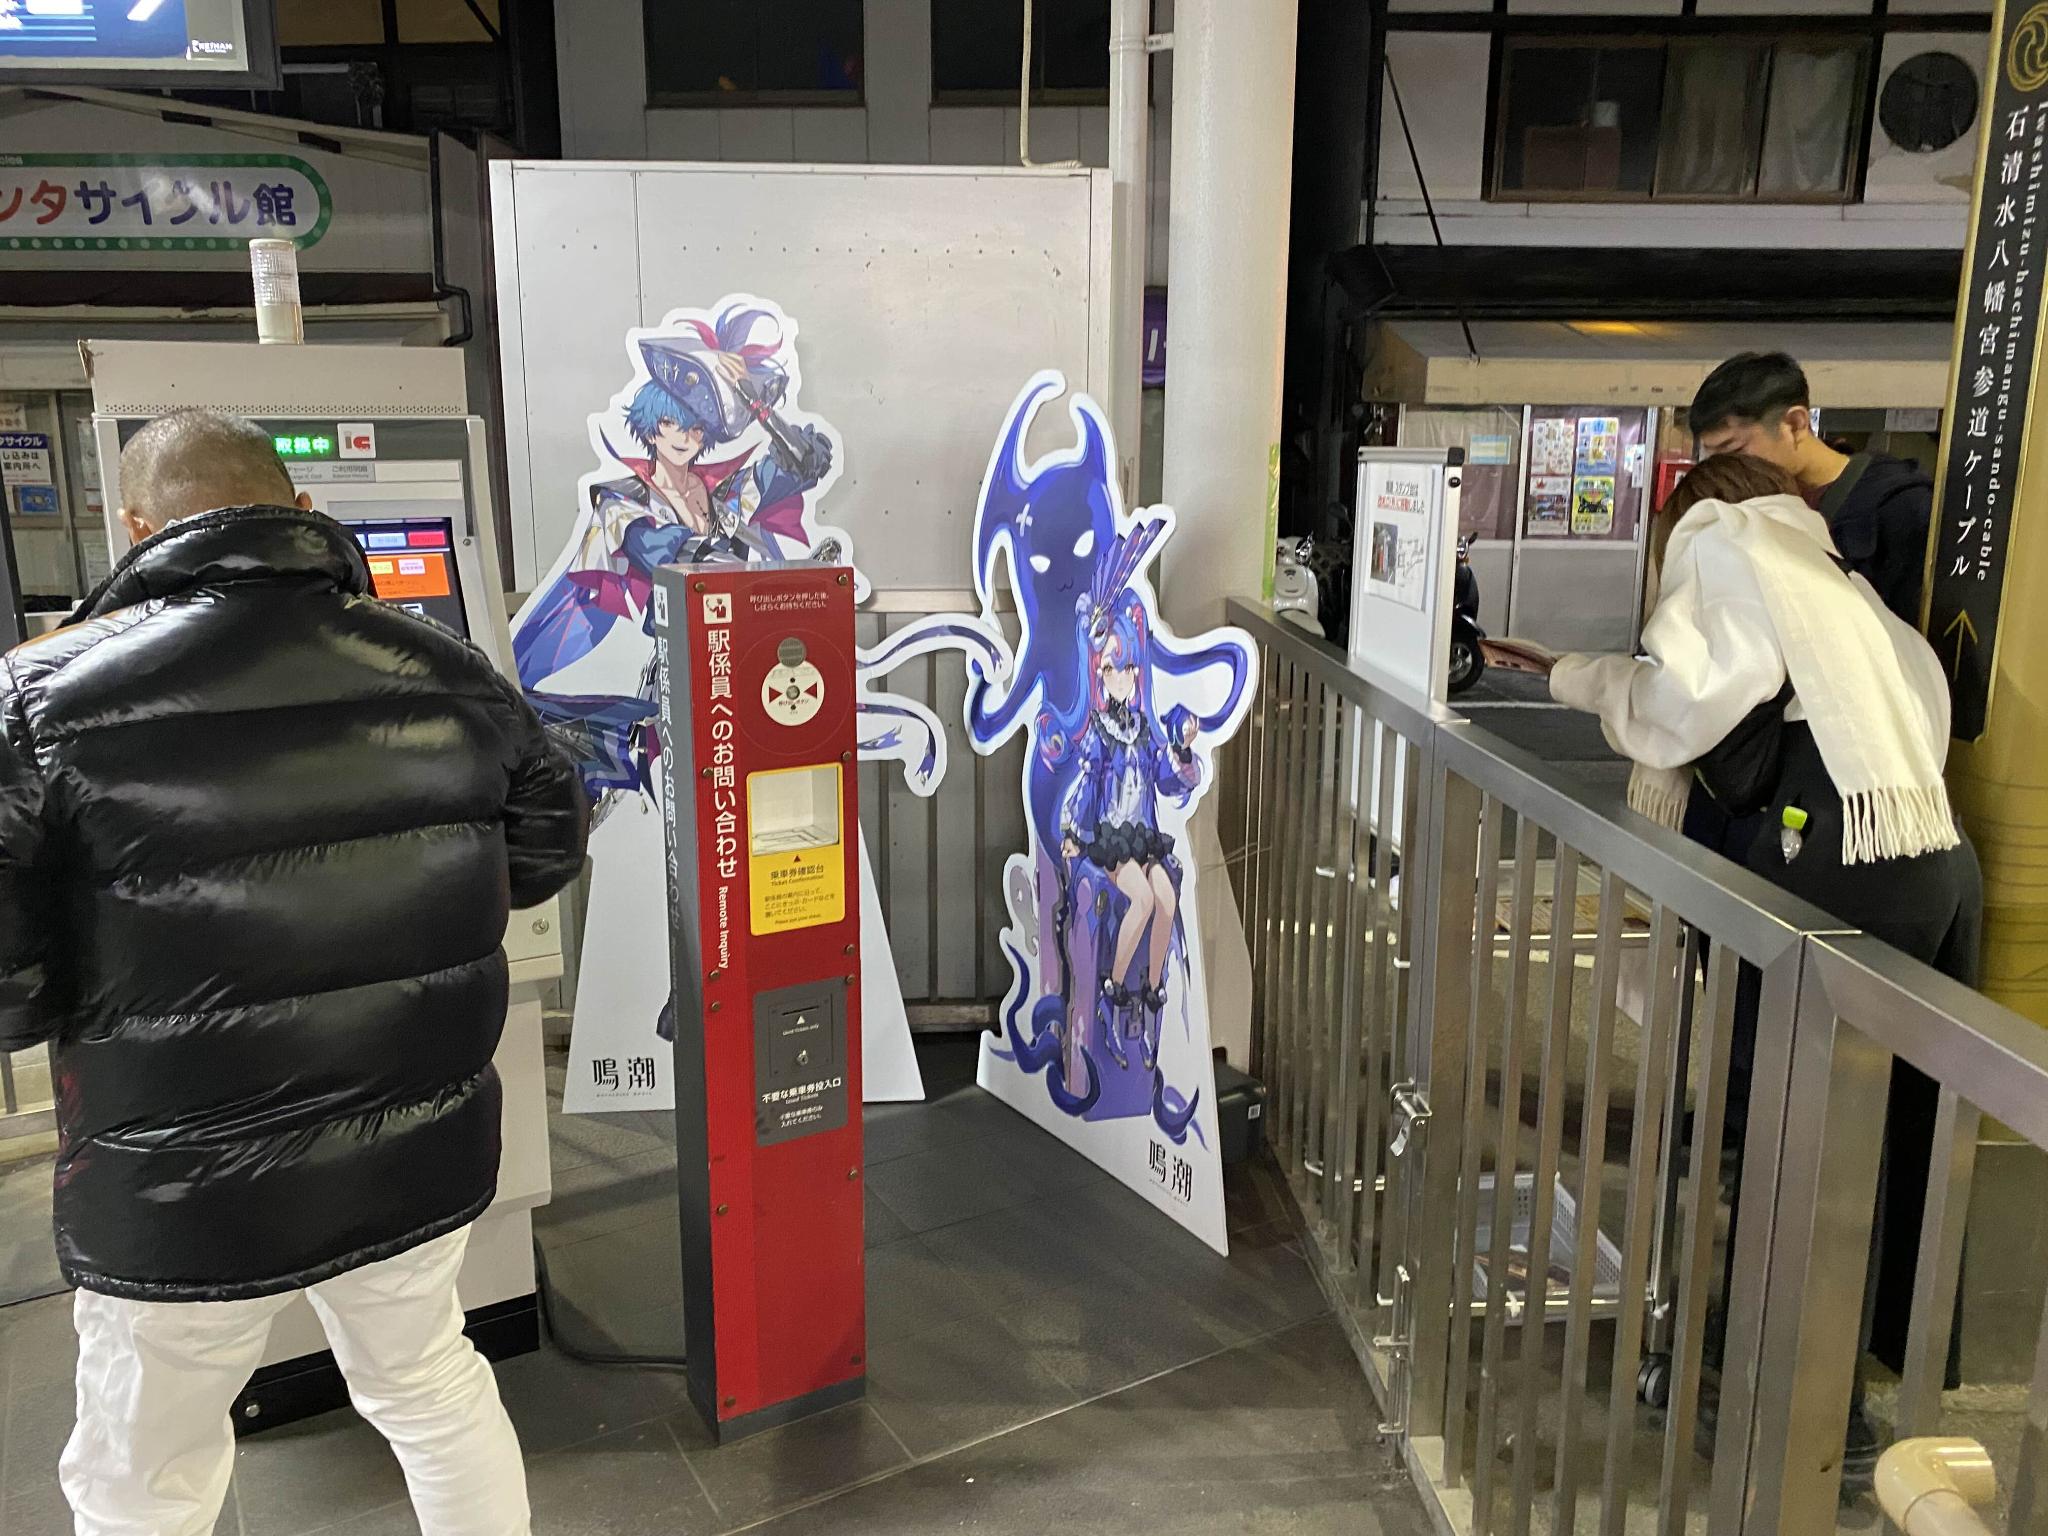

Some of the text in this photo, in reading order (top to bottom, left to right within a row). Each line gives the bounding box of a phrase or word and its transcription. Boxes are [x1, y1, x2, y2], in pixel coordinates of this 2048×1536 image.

[1950, 105, 2029, 577] 石清水八幡宮参道ケーブル
[708, 629, 737, 878] 駅係員へのお問い合わせ
[718, 886, 729, 969] Remote Inquiry
[592, 1057, 656, 1091] 鳴潮
[1149, 1139, 1192, 1202] 鳴潮
